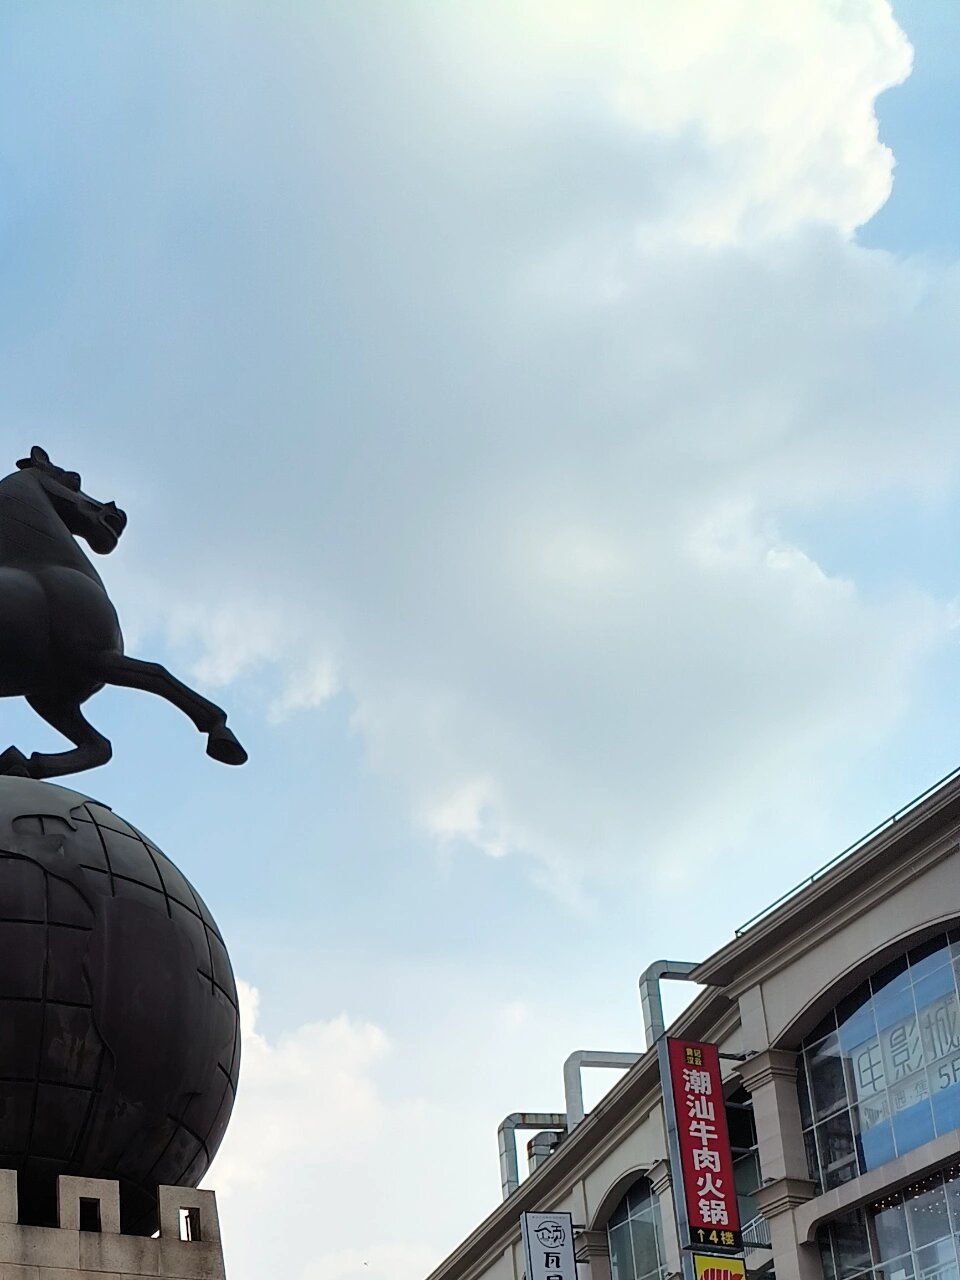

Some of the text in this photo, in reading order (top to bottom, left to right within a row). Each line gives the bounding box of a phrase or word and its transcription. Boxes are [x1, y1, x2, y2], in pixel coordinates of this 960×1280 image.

[682, 1068, 729, 1226] 潮汕牛肉火锅
[709, 1230, 735, 1246] 4楼
